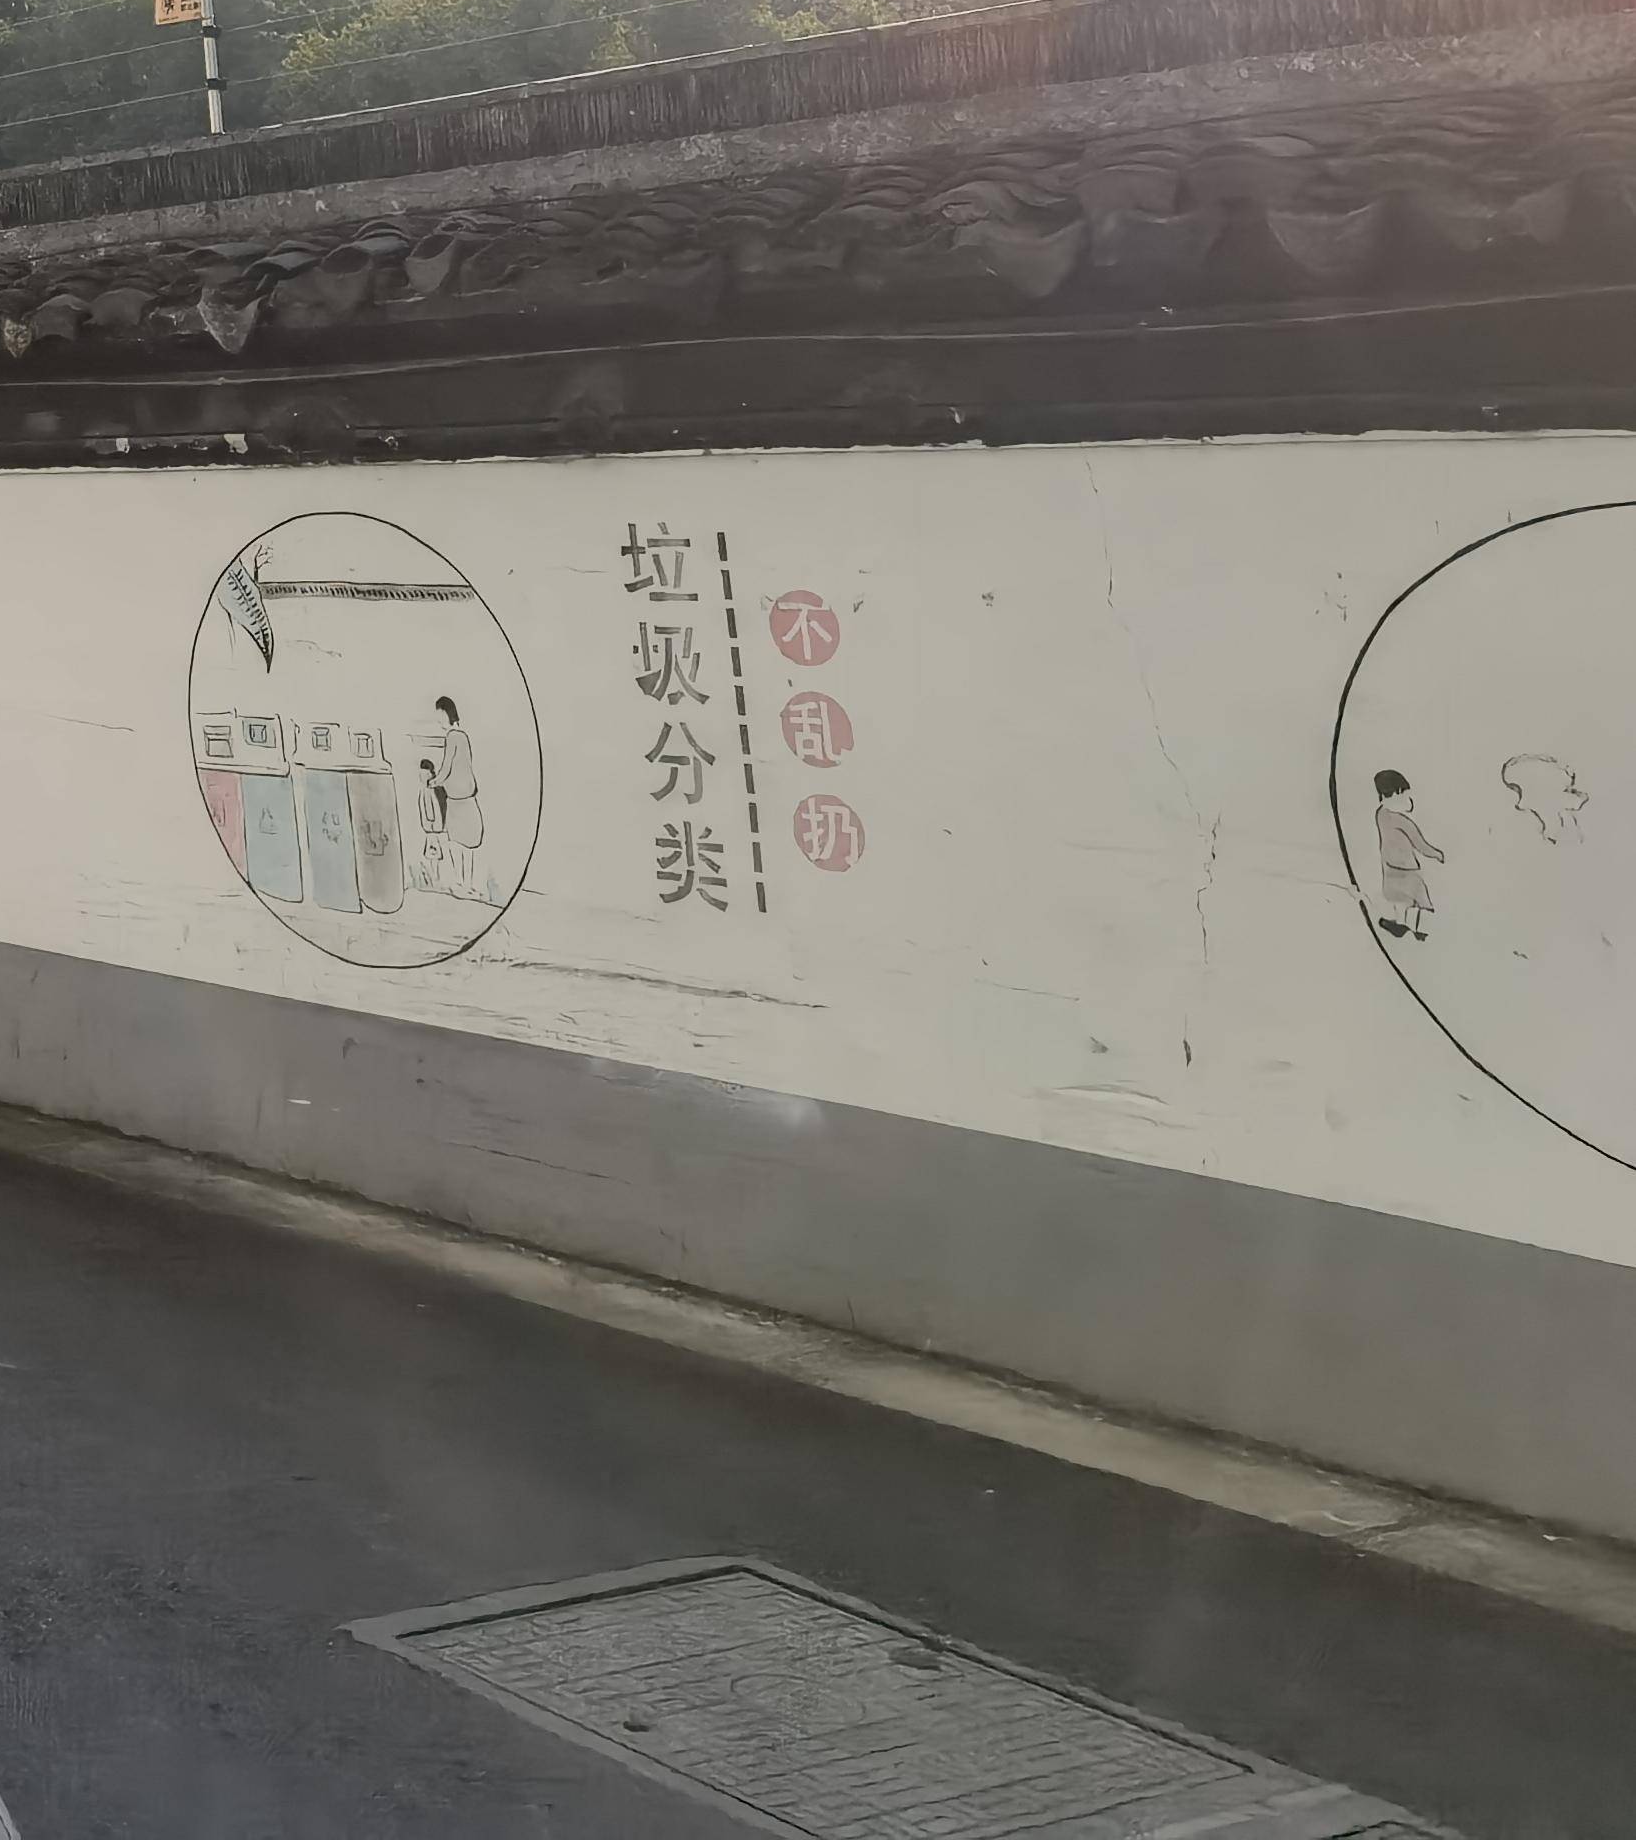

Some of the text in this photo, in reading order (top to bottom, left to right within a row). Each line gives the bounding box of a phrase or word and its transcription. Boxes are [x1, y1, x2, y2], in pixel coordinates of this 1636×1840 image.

[621, 521, 729, 913] 垃圾分类
[774, 598, 861, 868] 不乱扔
